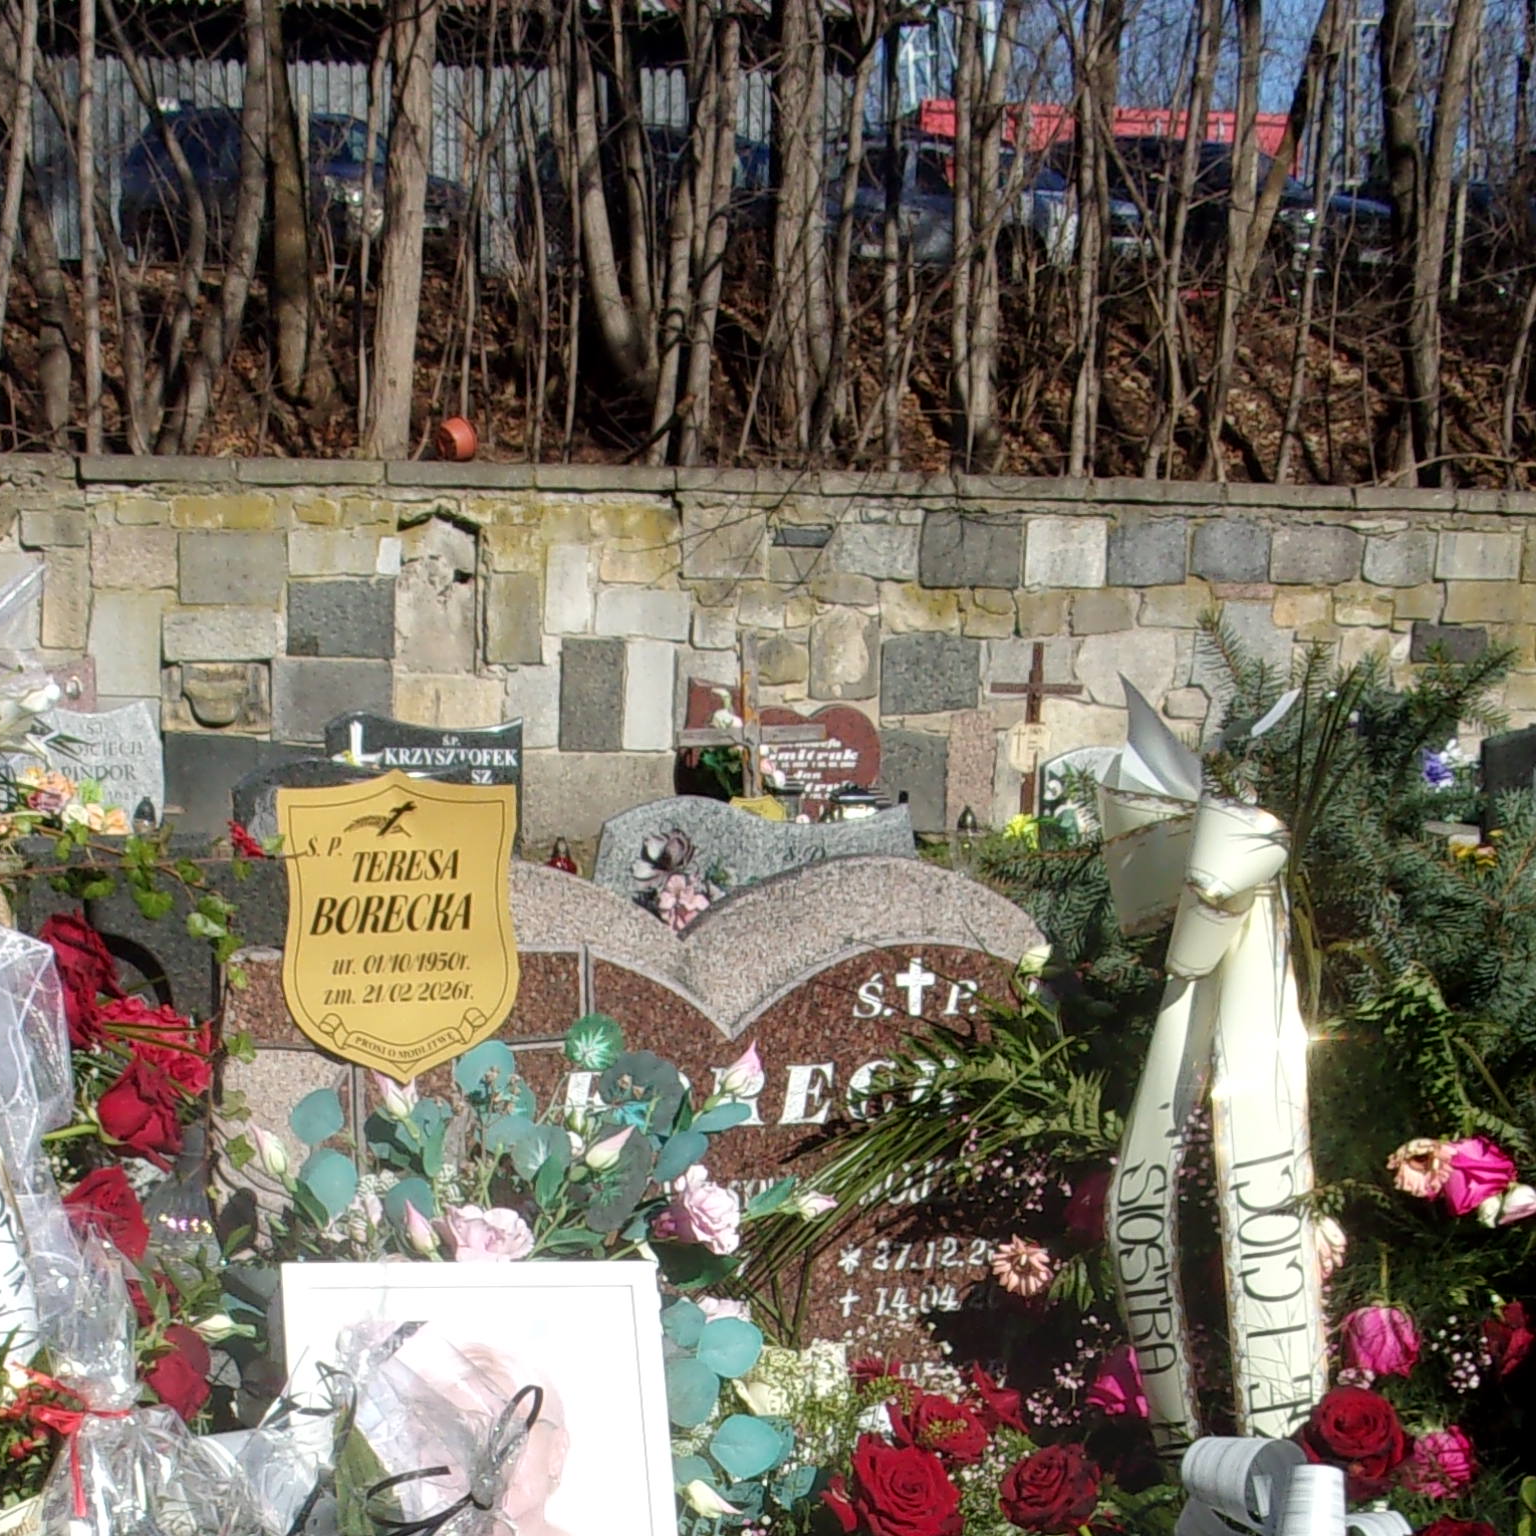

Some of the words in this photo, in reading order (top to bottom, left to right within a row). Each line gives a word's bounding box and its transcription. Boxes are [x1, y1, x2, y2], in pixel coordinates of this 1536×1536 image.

[352, 849, 459, 884] TERESA
[310, 892, 472, 937] BORECKA
[323, 987, 356, 1005] zm.
